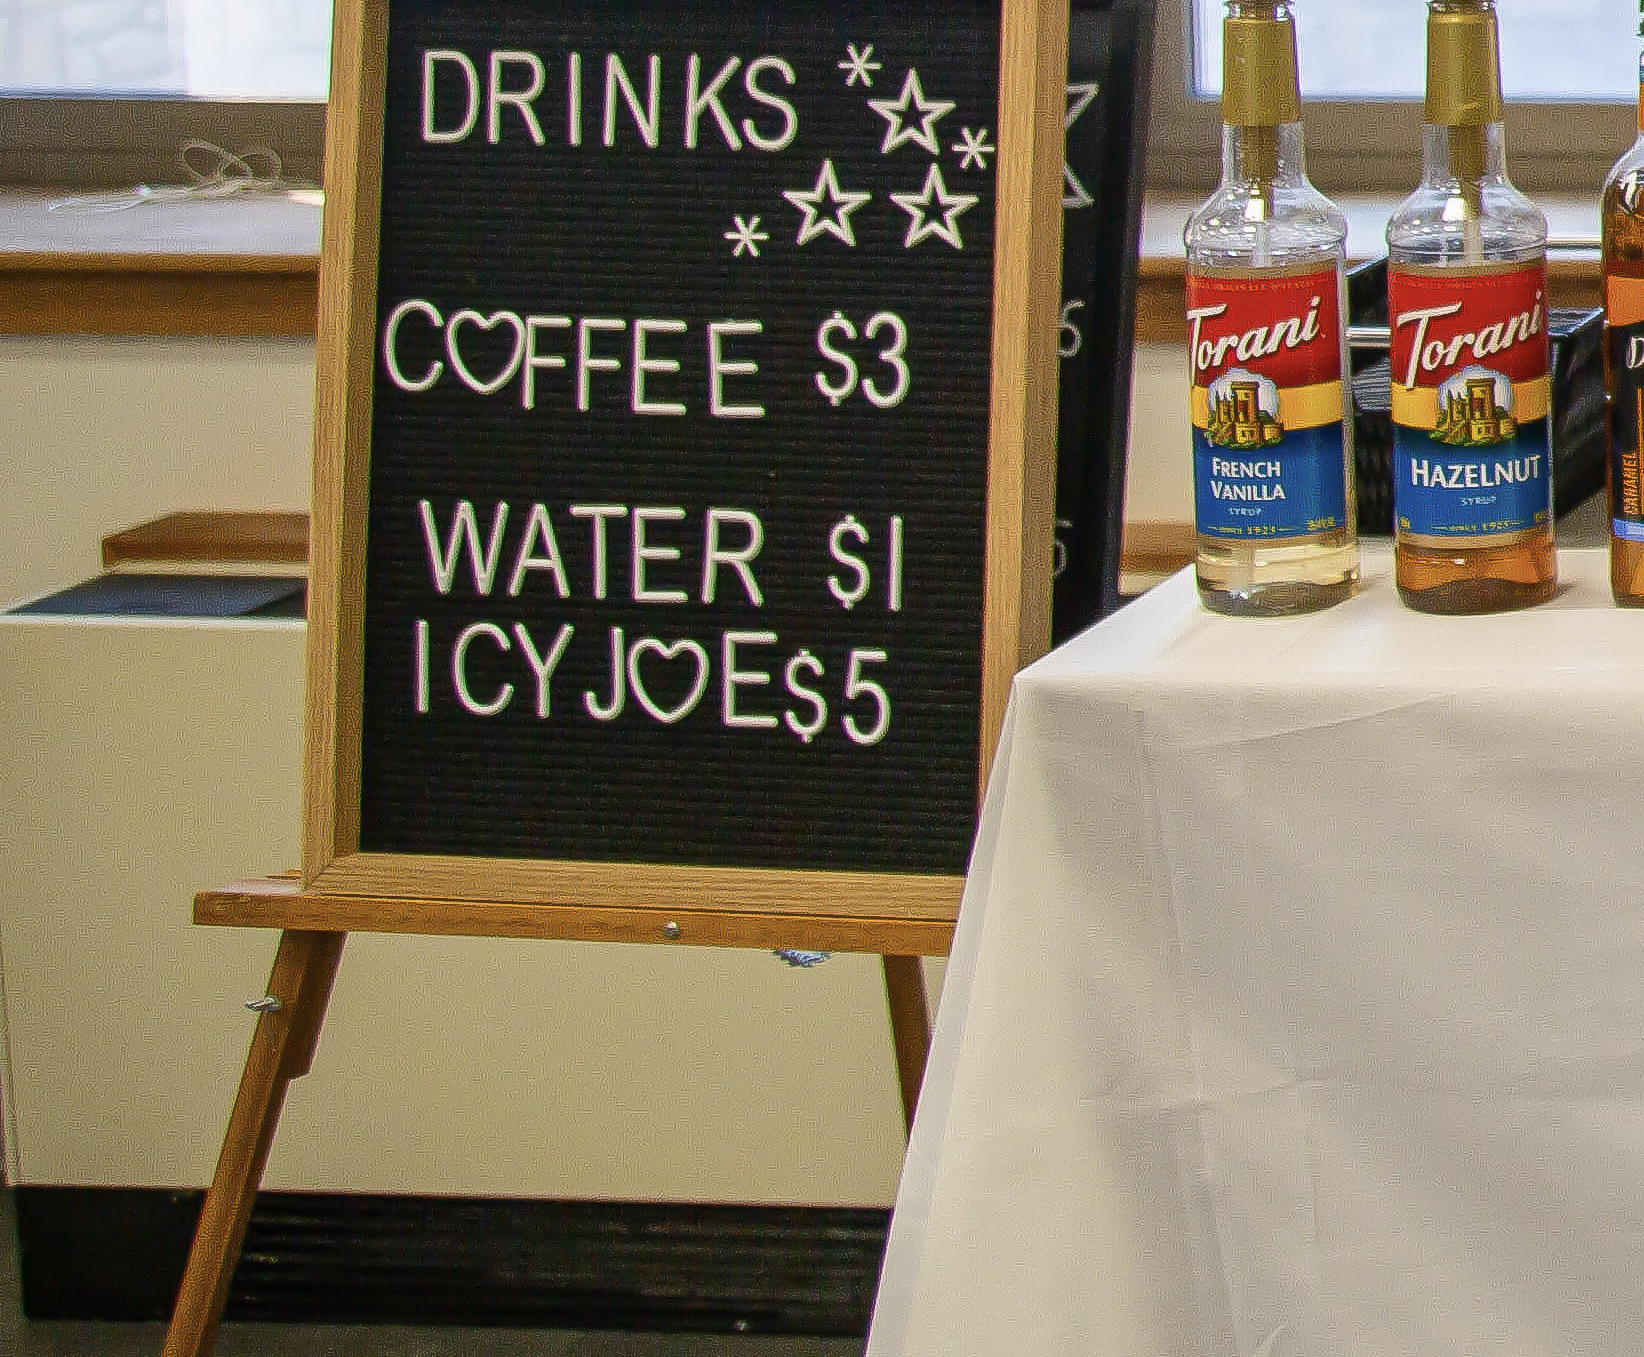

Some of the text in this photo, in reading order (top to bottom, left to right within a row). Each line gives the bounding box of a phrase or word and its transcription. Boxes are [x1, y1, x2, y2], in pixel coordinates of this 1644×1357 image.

[419, 47, 800, 153] DRINKS
[813, 311, 910, 408] $3
[1186, 296, 1321, 382] Torani
[1397, 292, 1543, 390] Torani
[1210, 480, 1286, 502] VANILLA
[1211, 457, 1281, 478] FRENCH
[1411, 454, 1541, 489] HAZELNUT
[419, 499, 903, 611] WATER $1
